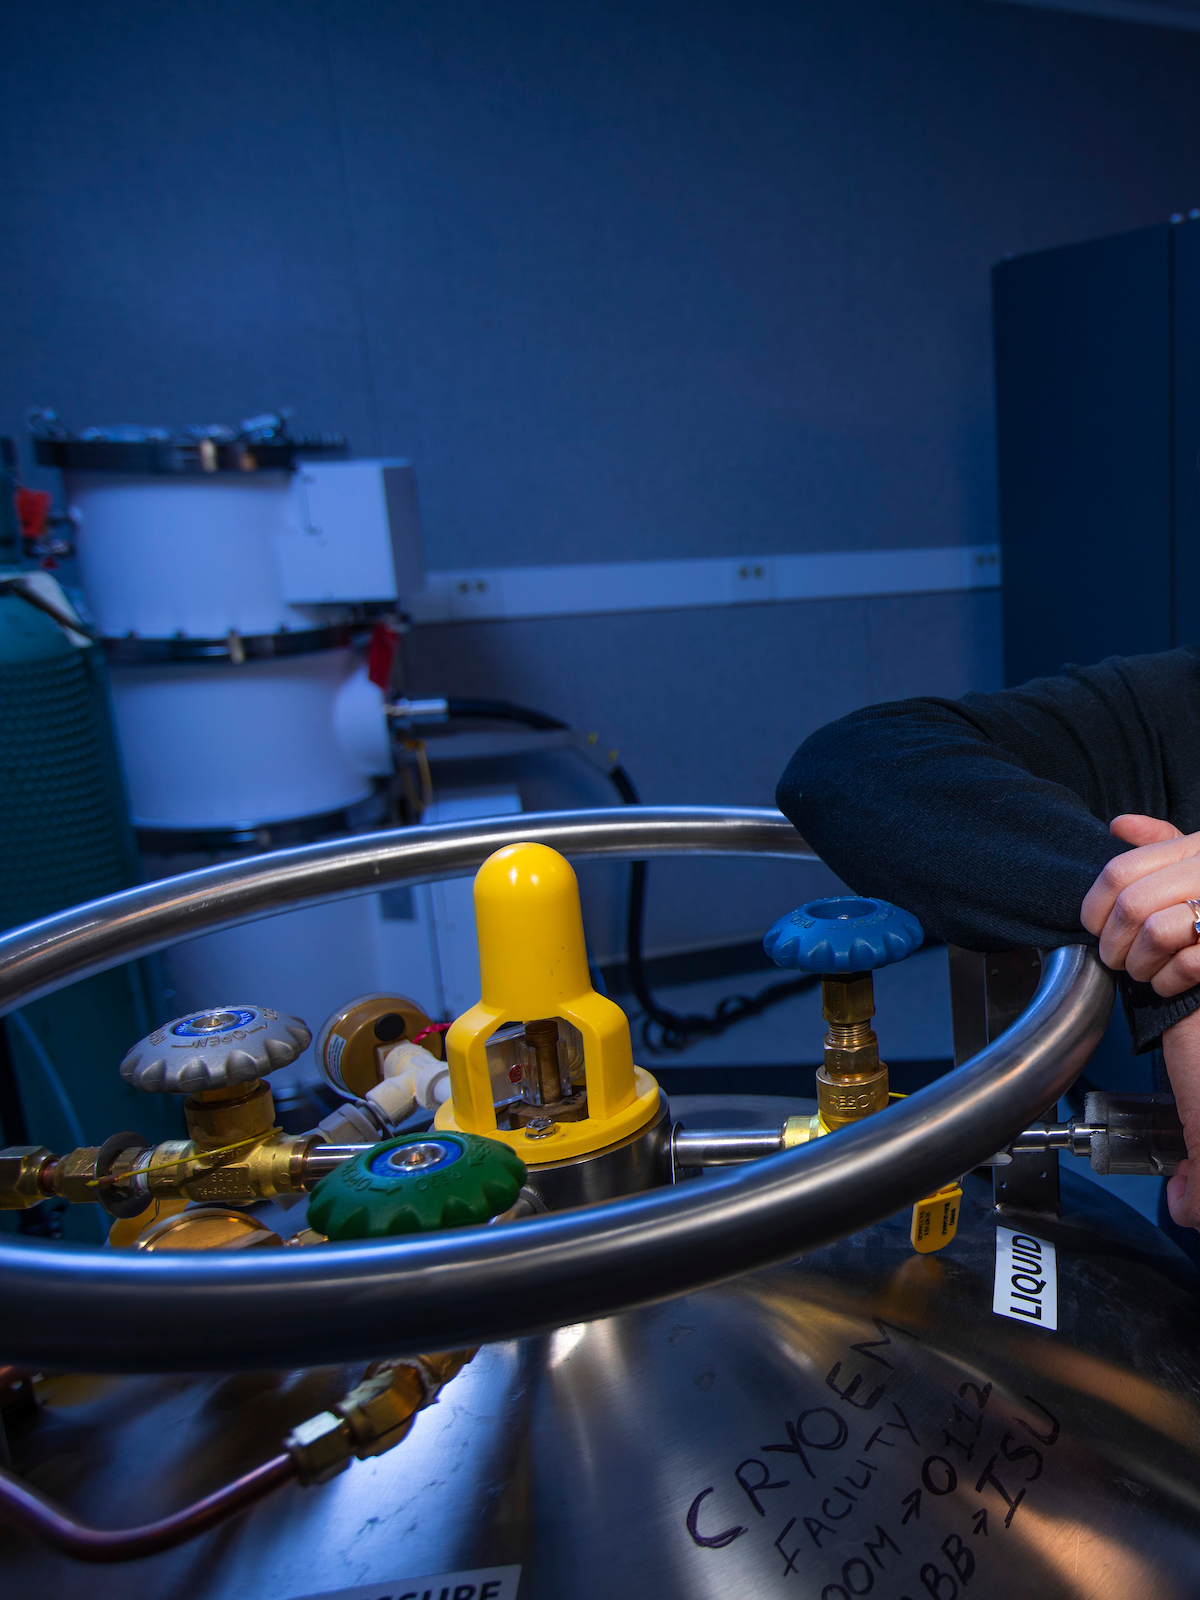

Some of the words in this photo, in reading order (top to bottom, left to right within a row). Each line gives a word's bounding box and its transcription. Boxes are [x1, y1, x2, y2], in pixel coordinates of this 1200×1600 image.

[190, 1029, 247, 1050] OPEN
[1010, 1234, 1048, 1321] LIQUID
[775, 1402, 921, 1577] FACILITY
[900, 1533, 976, 1600] BB
[975, 1395, 1061, 1528] ISU
